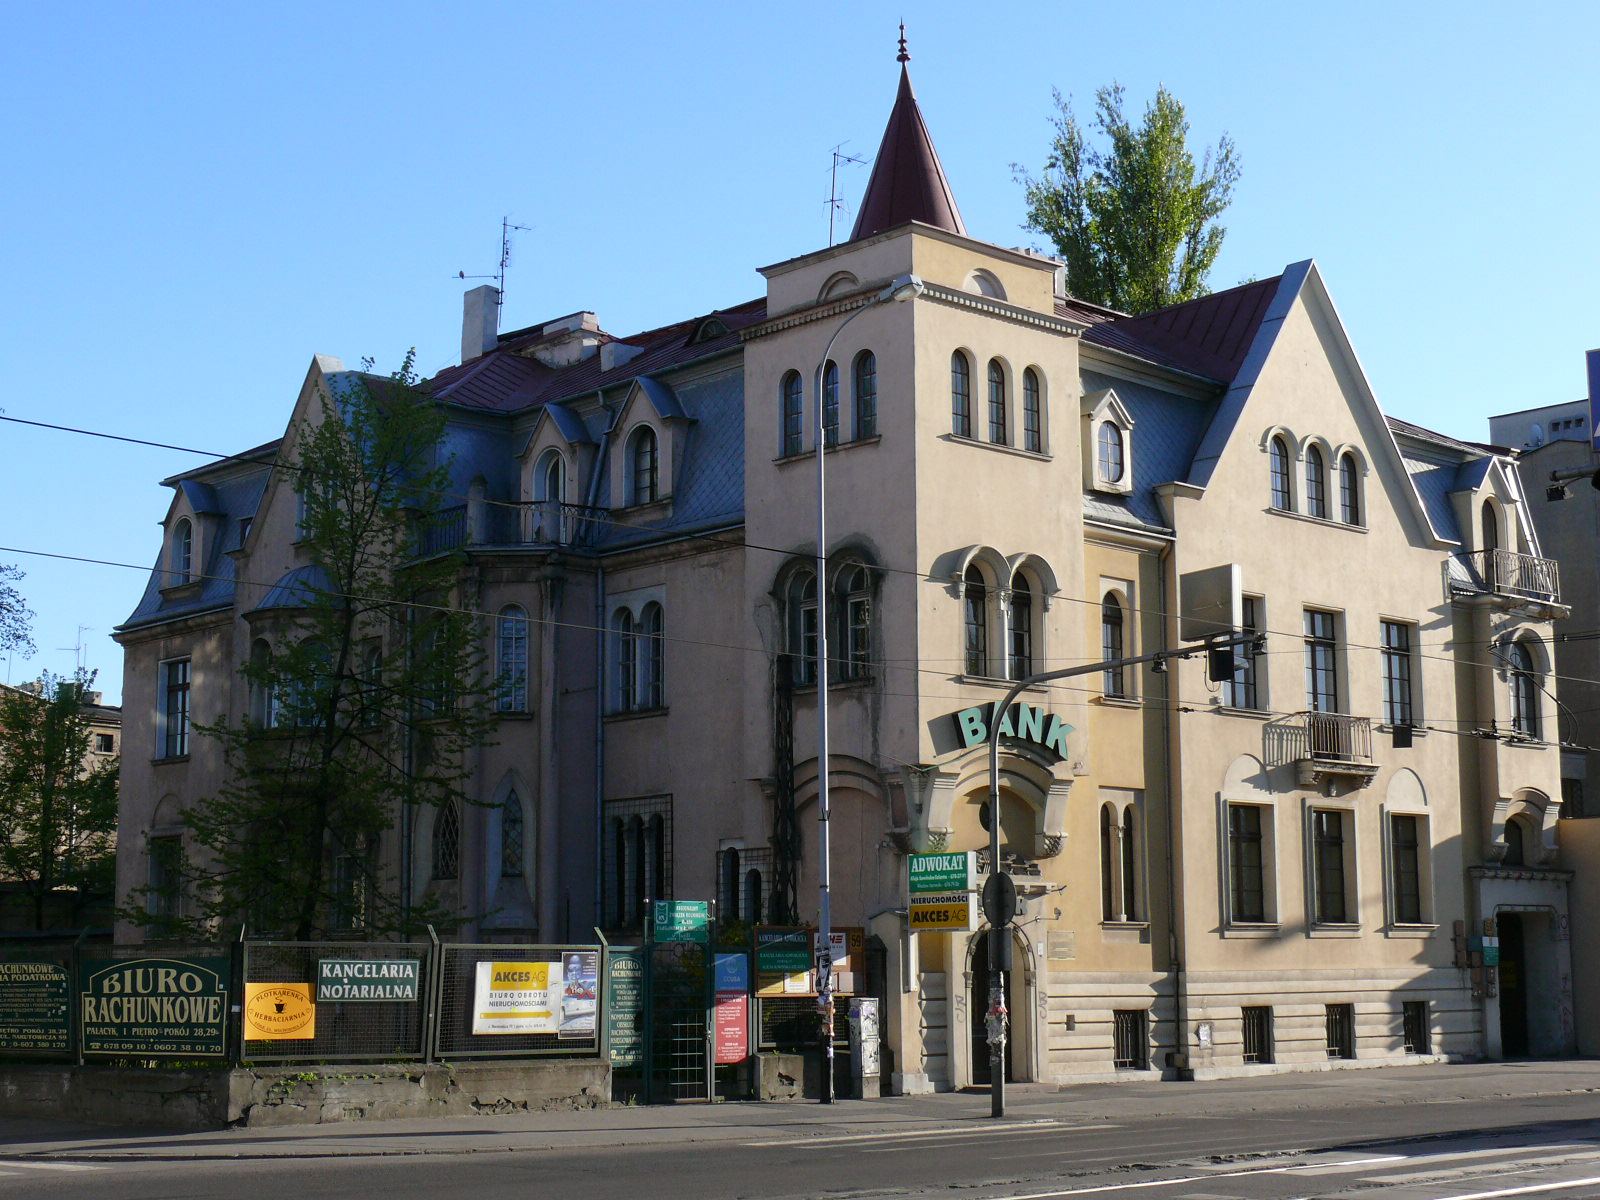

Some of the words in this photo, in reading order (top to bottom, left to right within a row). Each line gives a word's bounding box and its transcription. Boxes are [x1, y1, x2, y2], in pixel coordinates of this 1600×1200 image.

[958, 701, 1074, 761] BANK
[911, 855, 965, 873] ADWOKAT
[911, 896, 968, 905] NIERUCHOMOŚCI
[913, 911, 949, 923] AKCES
[951, 910, 967, 922] AG
[851, 935, 861, 947] 59
[322, 963, 414, 978] KANCELARIA
[614, 960, 639, 970] BIURO
[11, 973, 66, 982] PODATKOWA
[102, 968, 203, 994] BIURO
[494, 972, 530, 983] AKCES
[532, 970, 549, 983] AG
[320, 985, 413, 998] NOTARIALNA
[84, 996, 221, 1024] RACHUNKOWE
[254, 1011, 306, 1023] HERBACIARNIA
[132, 1028, 159, 1037] PIĘTRO
[164, 1027, 190, 1036] POKÓJ
[154, 1043, 177, 1051] 0602
